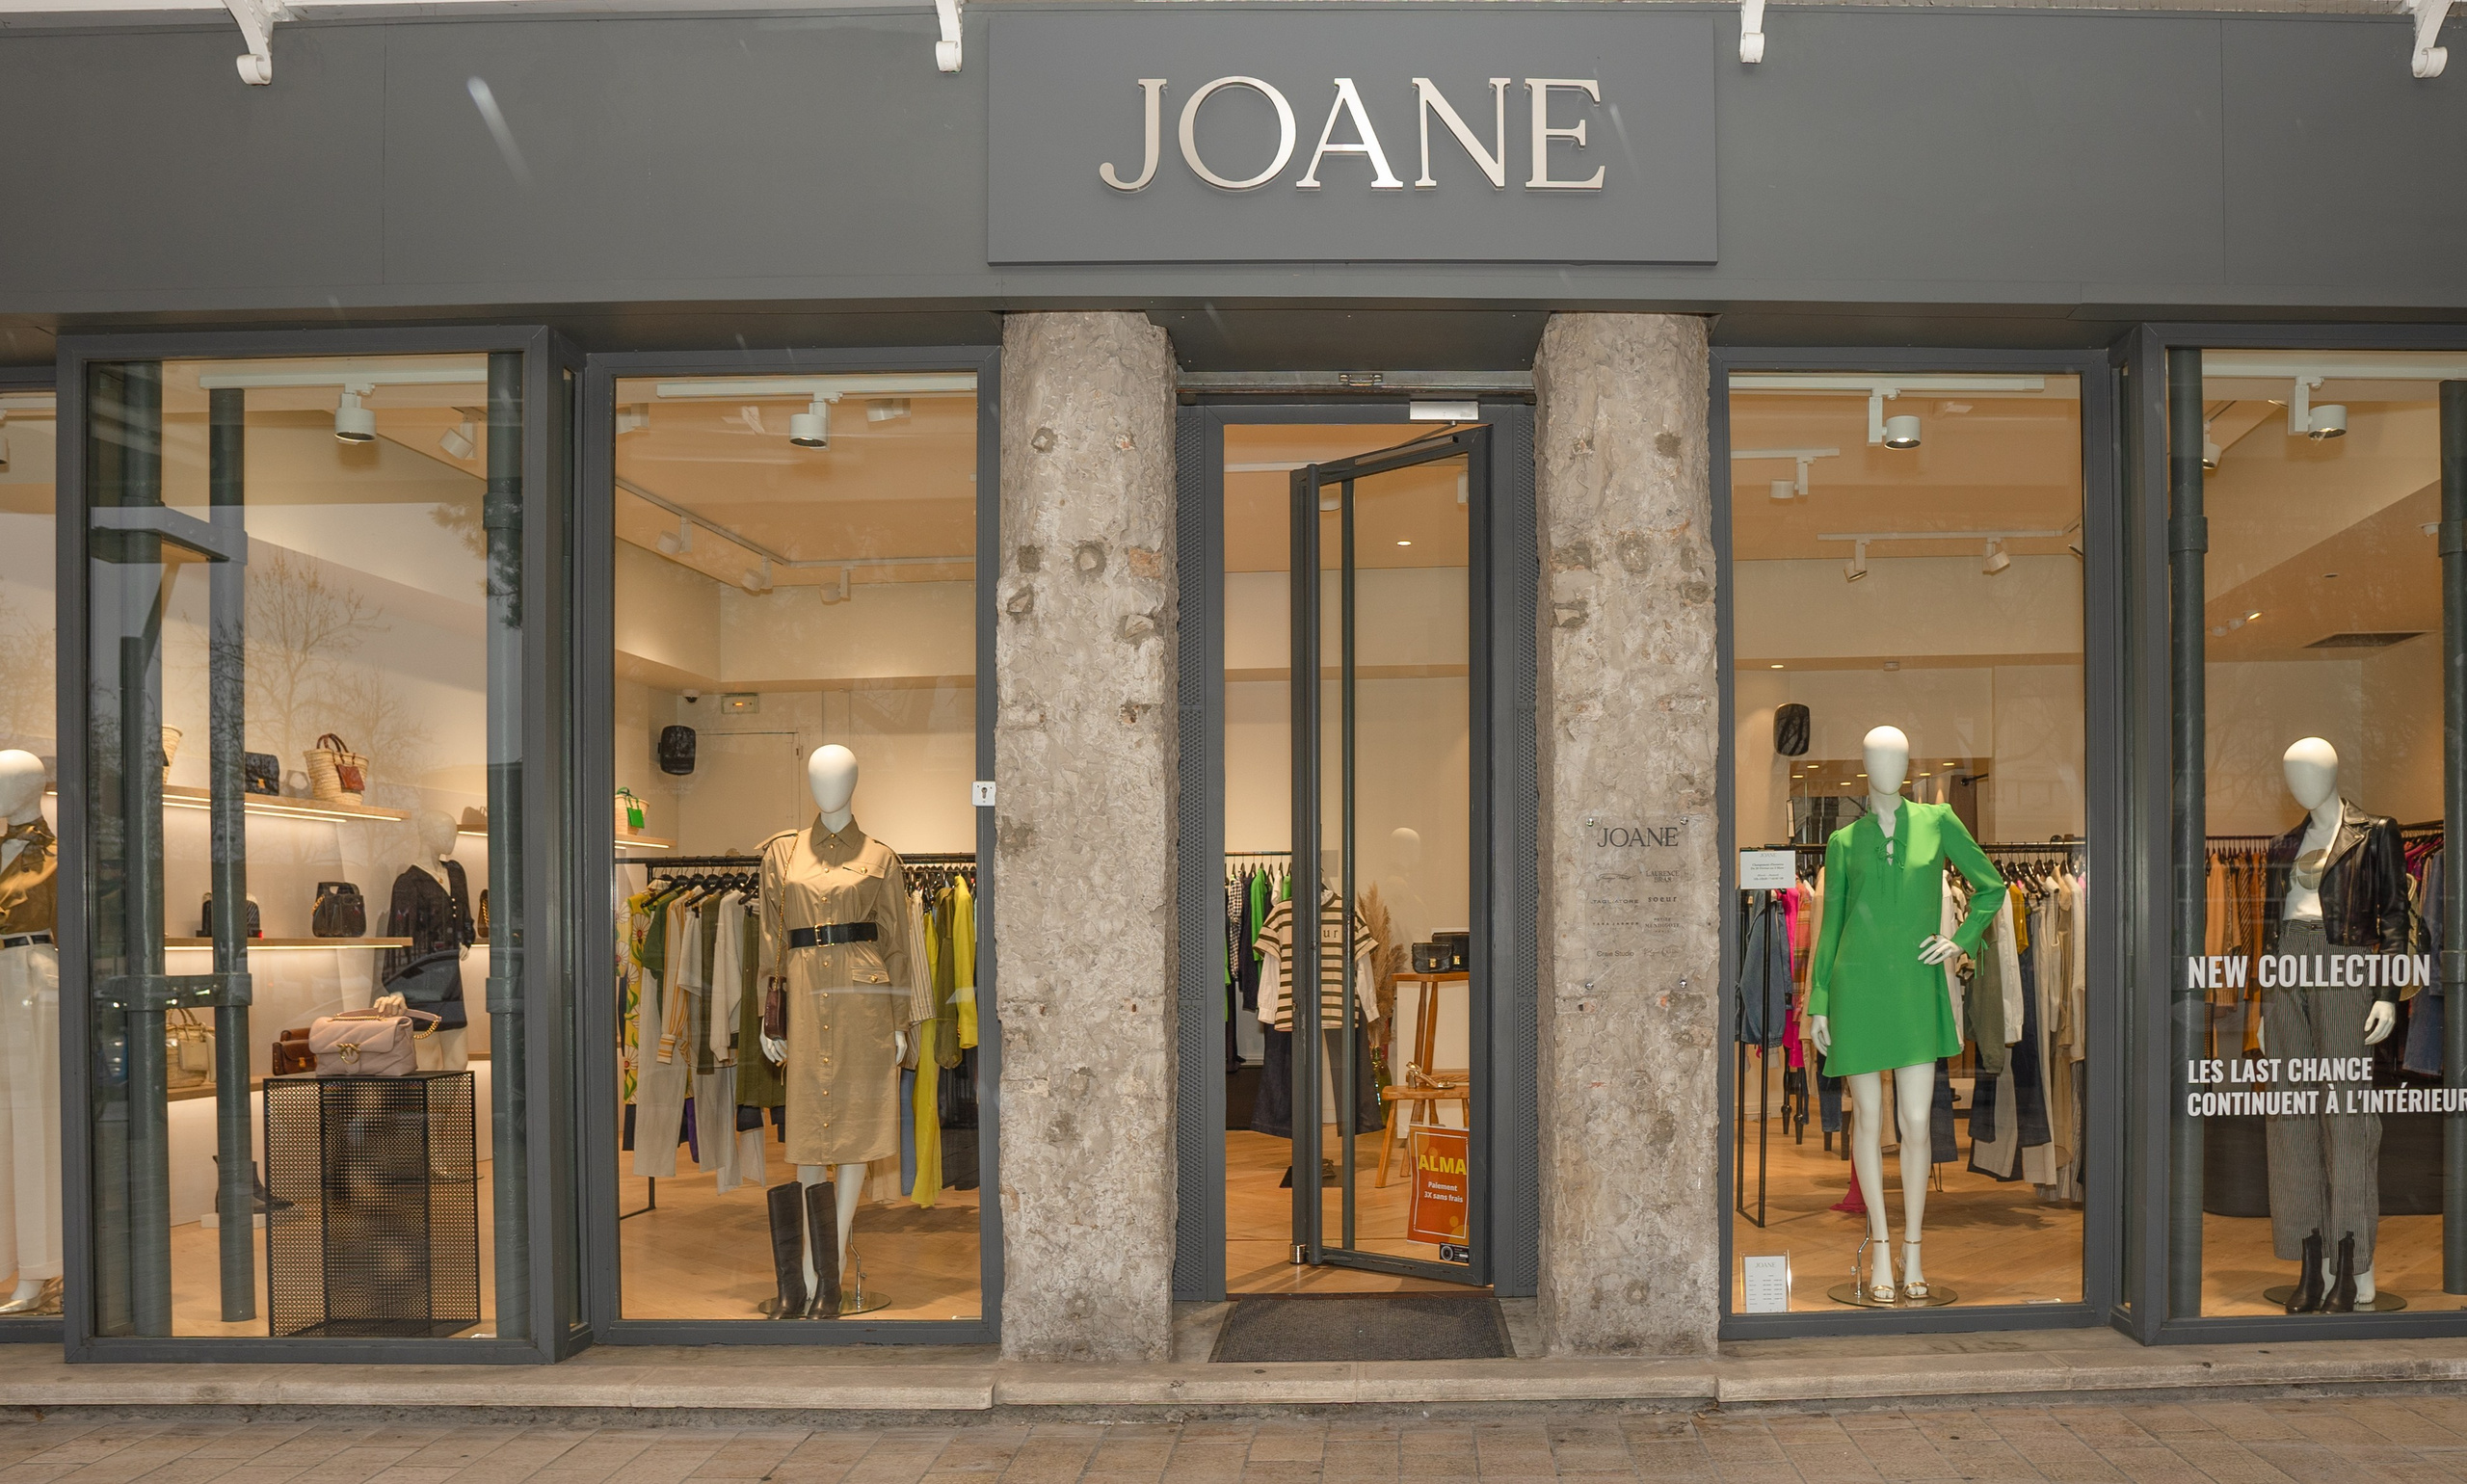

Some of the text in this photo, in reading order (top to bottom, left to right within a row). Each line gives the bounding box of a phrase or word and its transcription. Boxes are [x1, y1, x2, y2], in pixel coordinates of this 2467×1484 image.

[1099, 75, 1606, 193] JOANE
[1597, 827, 1679, 848] JOANE
[2188, 954, 2430, 989] NEW COLLECTION
[2188, 1057, 2373, 1084] LES LAST CHANCE
[2188, 1091, 2319, 1117] CONTINUENT
[2325, 1083, 2340, 1114] À
[1419, 1154, 1467, 1176] ALMA
[1424, 1190, 1464, 1204] 3X sans frais
[1428, 1180, 1458, 1192] Paiement
